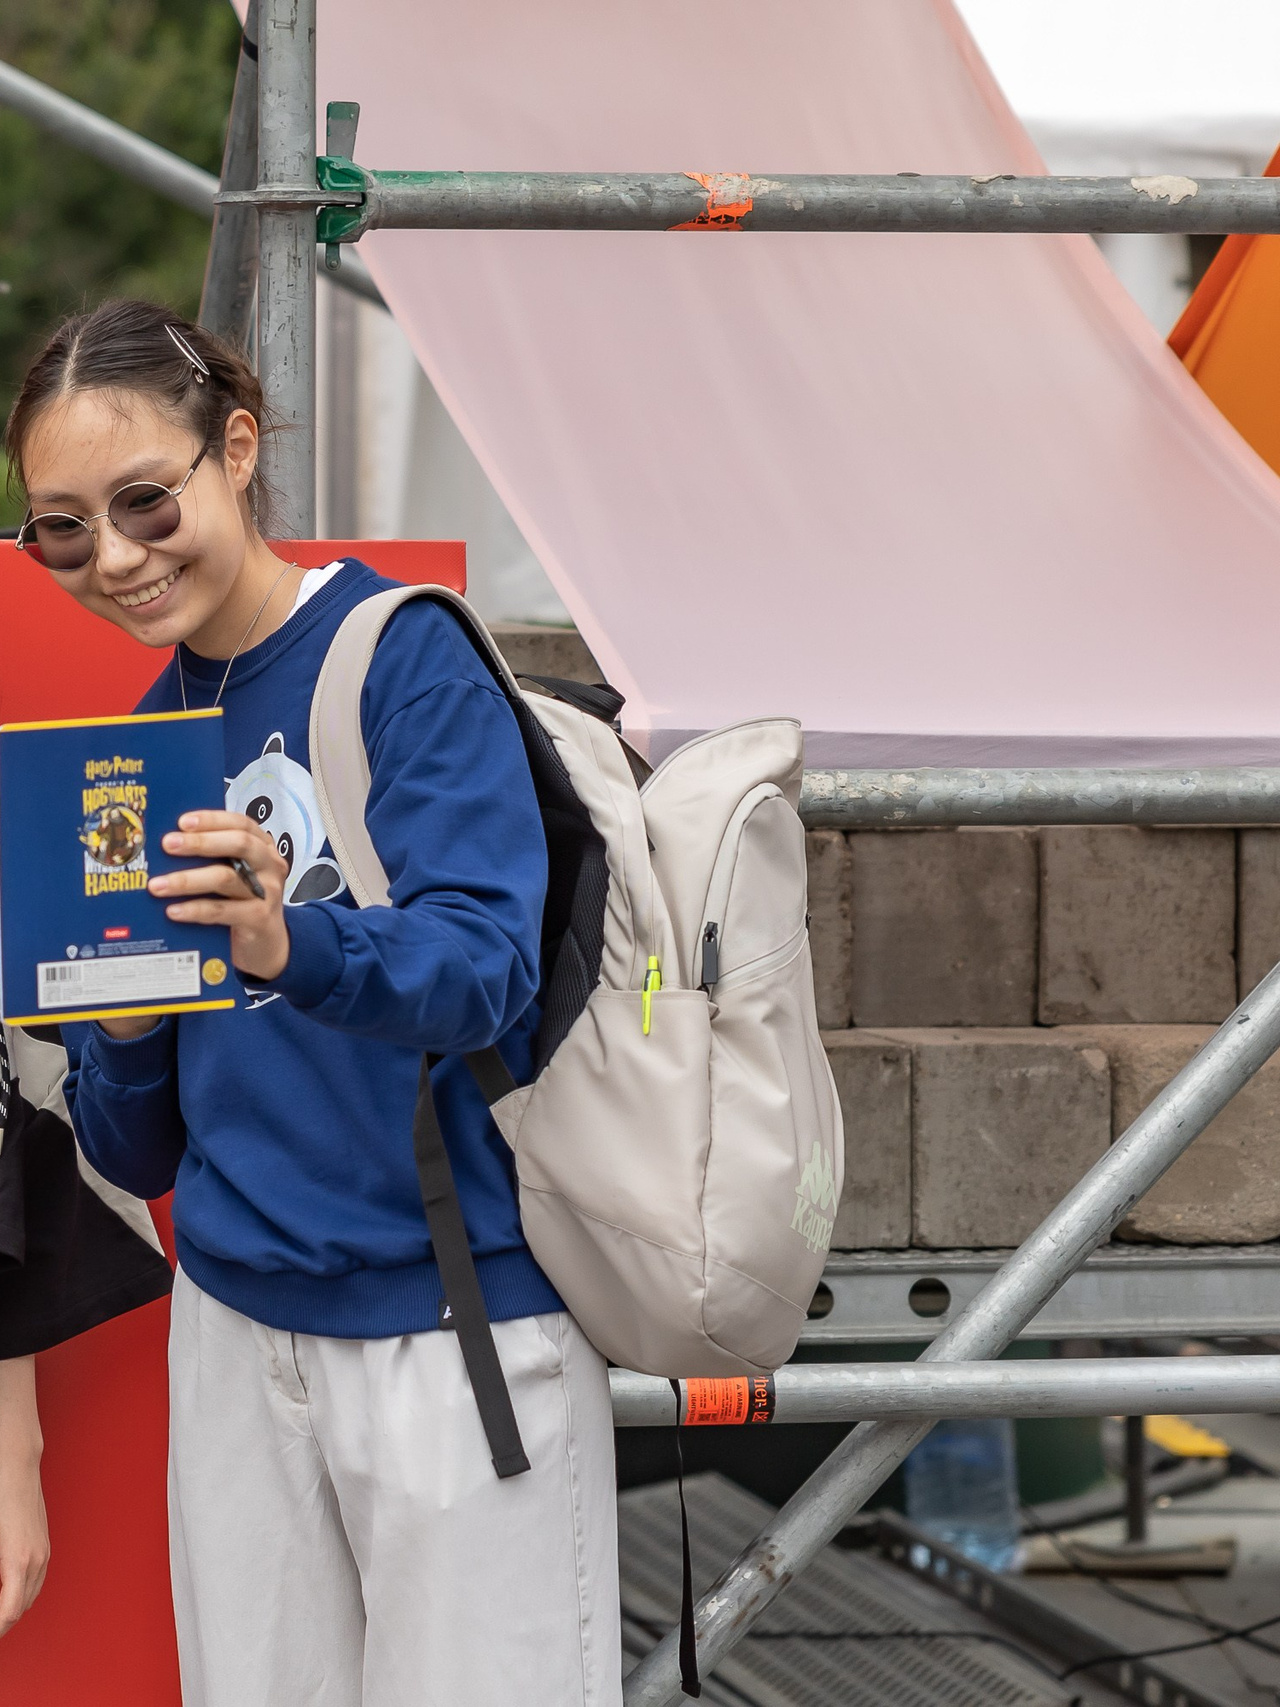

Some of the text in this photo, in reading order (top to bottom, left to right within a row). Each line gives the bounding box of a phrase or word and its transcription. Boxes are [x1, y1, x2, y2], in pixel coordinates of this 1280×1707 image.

[85, 756, 144, 780] Harry Potter
[82, 785, 147, 815] HOGWARTS
[85, 870, 149, 896] HAGRID
[790, 1195, 833, 1254] Kappa
